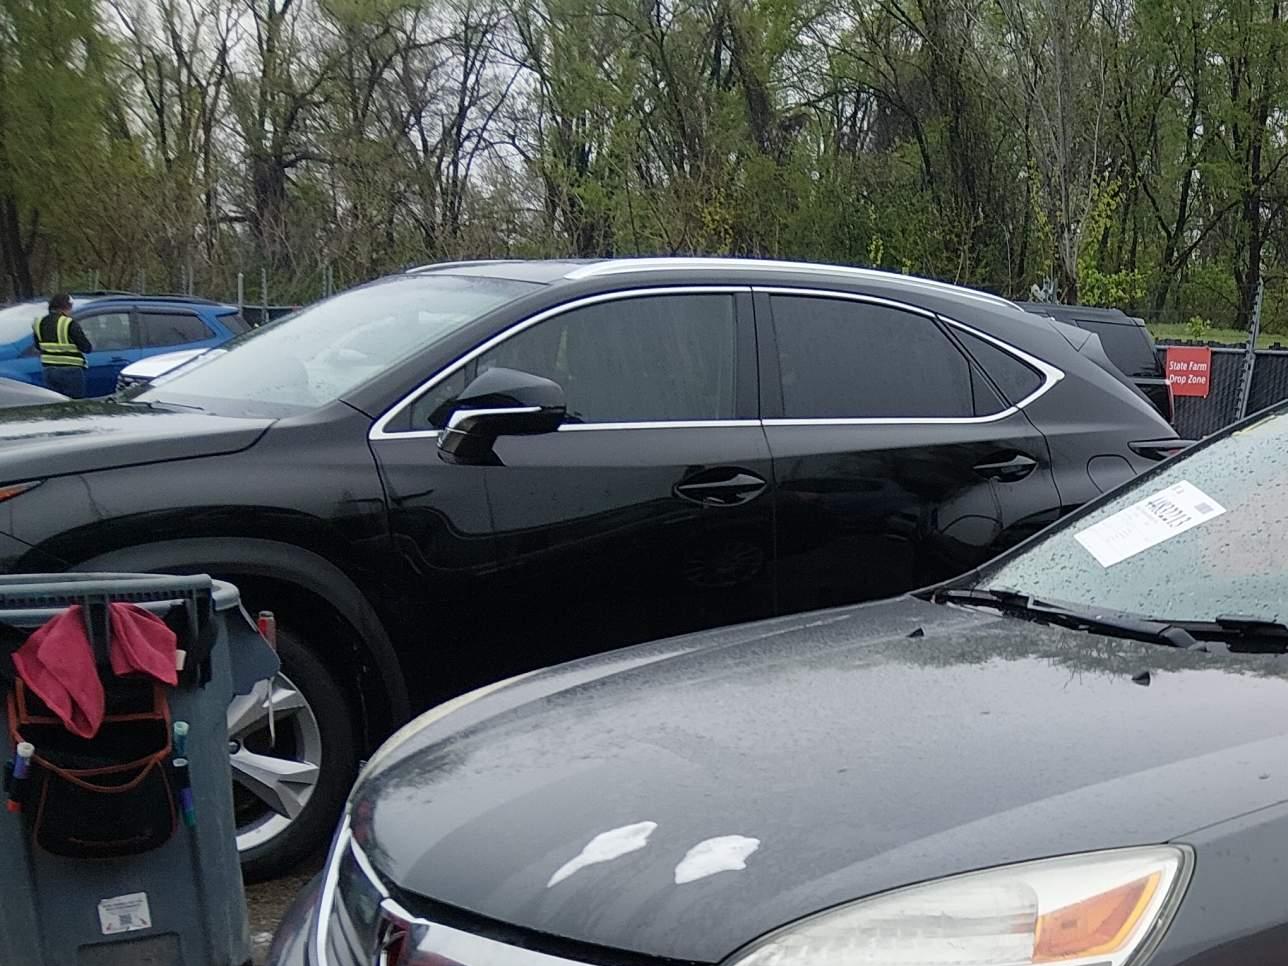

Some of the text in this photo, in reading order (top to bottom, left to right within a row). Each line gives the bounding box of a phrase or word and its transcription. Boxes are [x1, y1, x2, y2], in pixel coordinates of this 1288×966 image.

[1169, 361, 1207, 371] State Farm
[1169, 374, 1206, 385] Drop Zone
